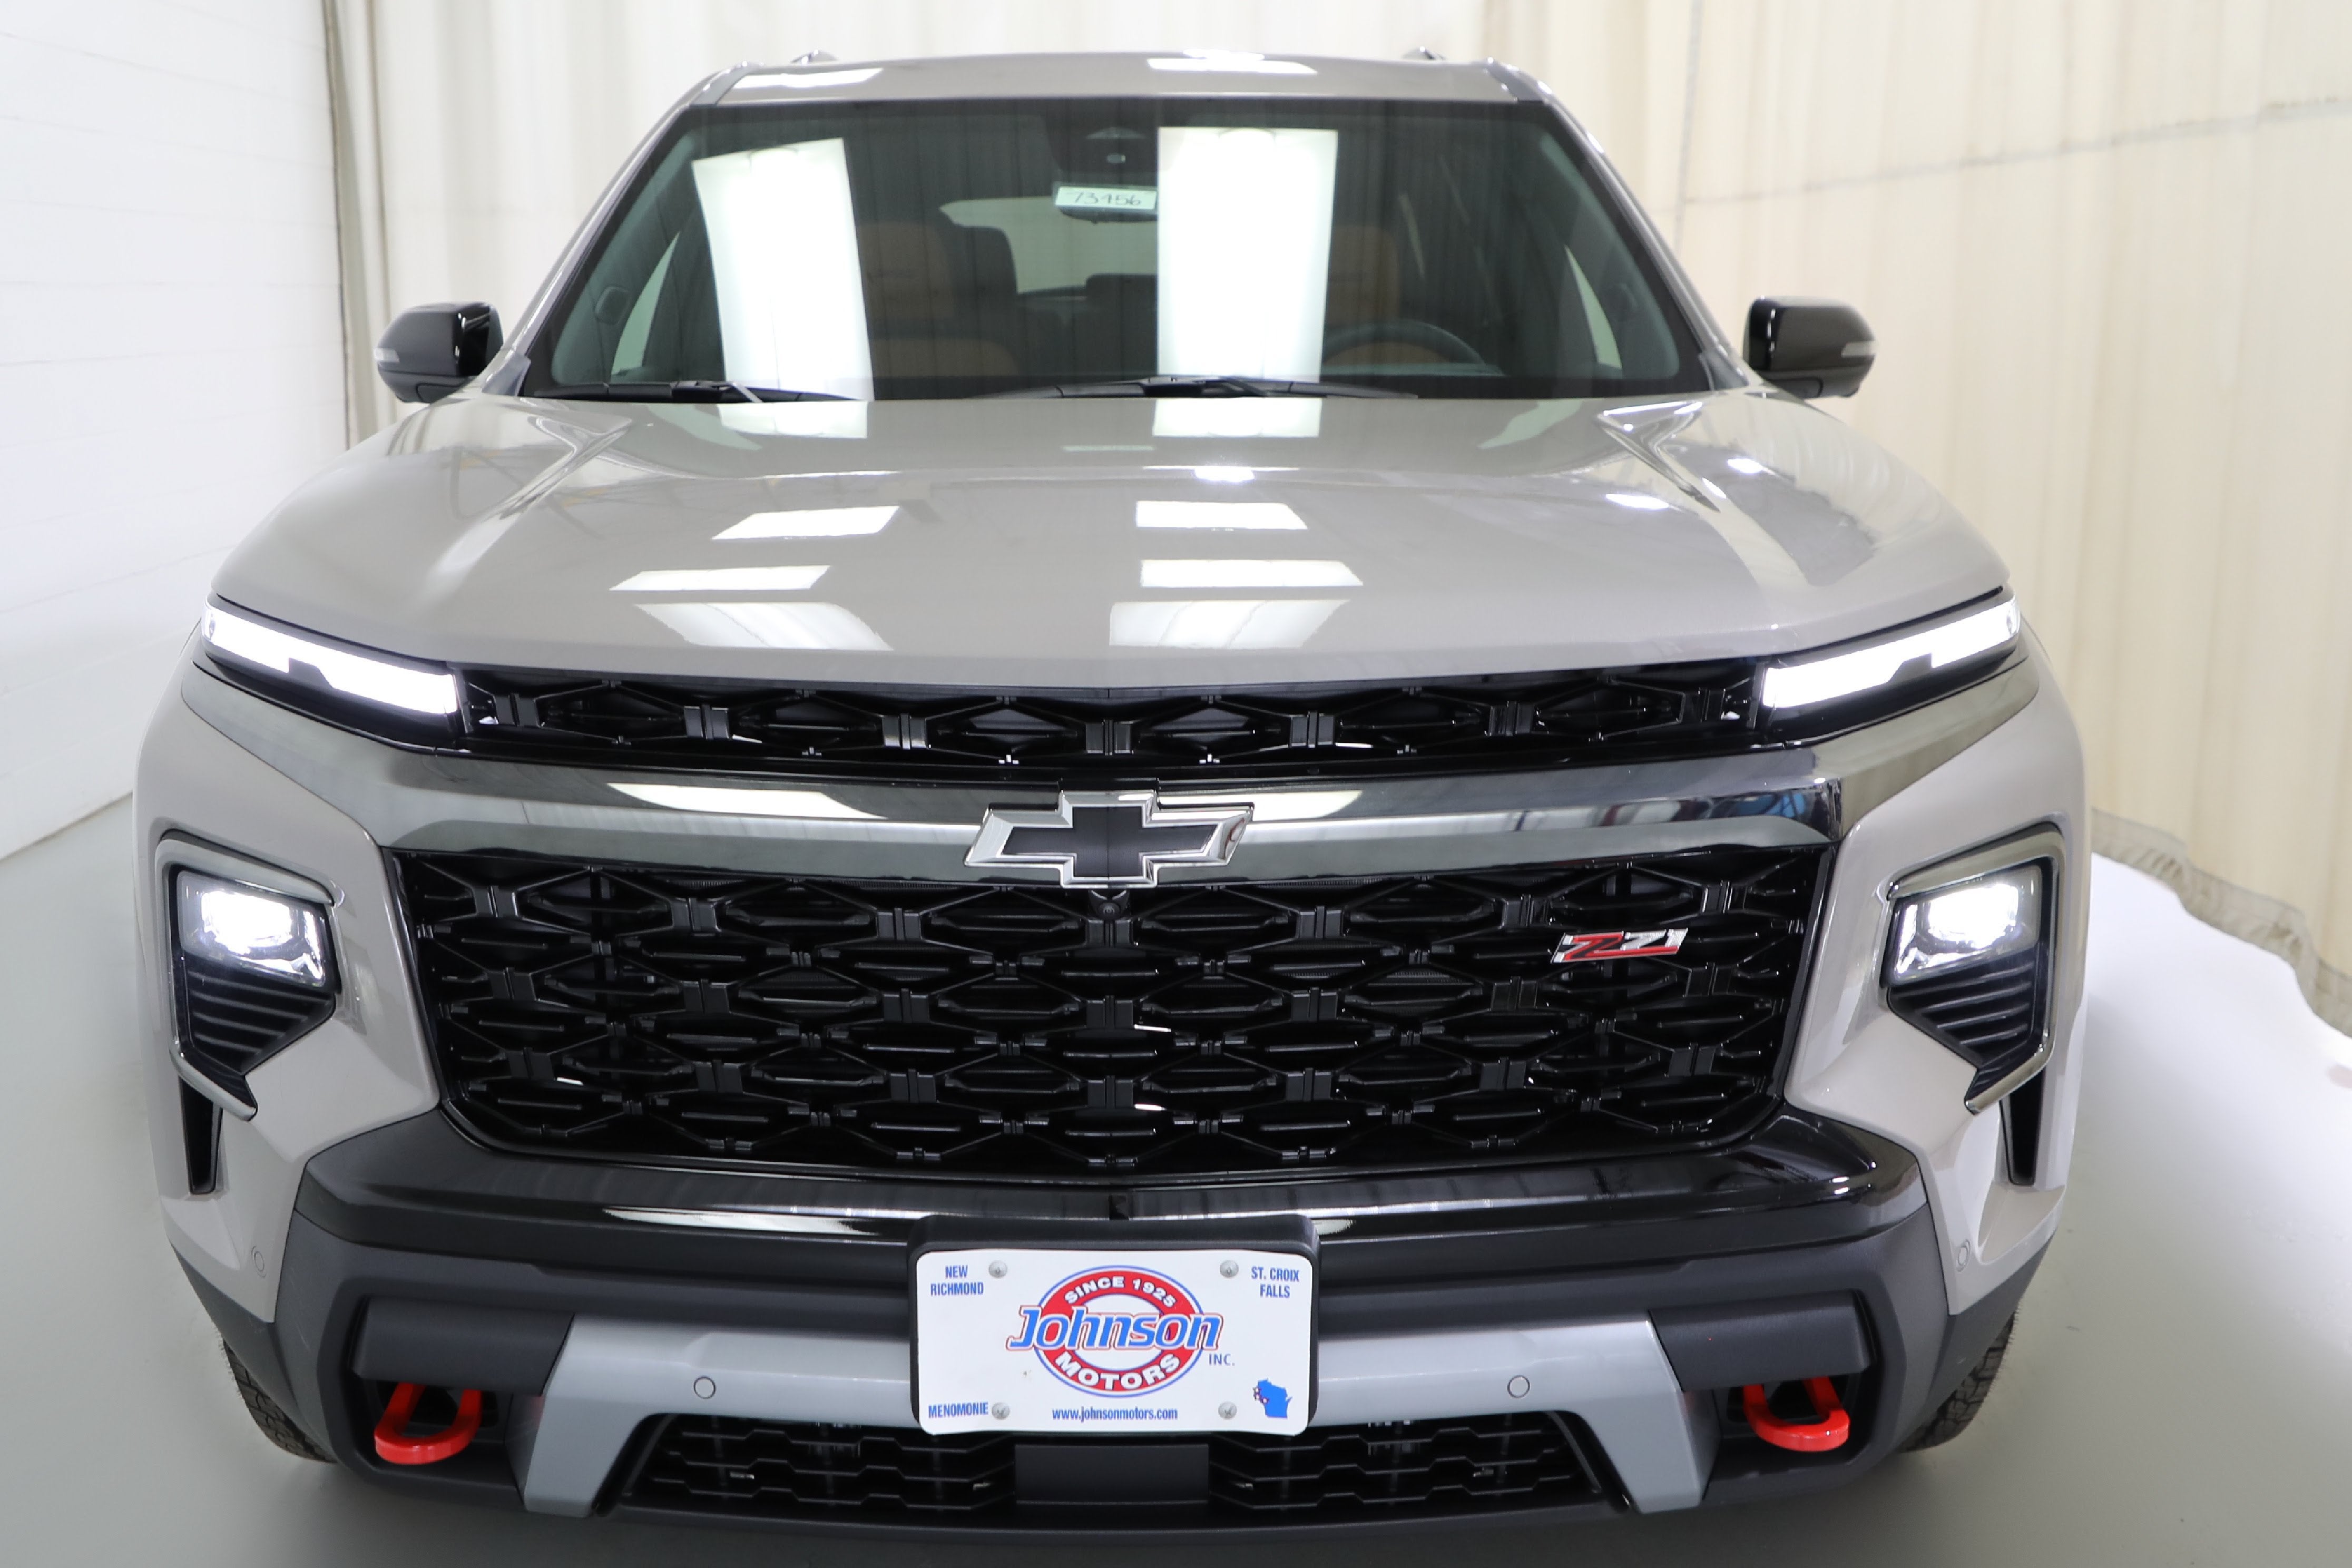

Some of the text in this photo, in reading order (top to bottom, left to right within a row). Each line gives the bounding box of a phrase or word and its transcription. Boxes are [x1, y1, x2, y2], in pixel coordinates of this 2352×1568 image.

[1550, 927, 1688, 963] Z71
[945, 1265, 968, 1279] NEW
[1251, 1266, 1300, 1282] ST. CROIX
[930, 1281, 984, 1296] RICHMOND
[1064, 1276, 1178, 1308] SINCE 1925
[1260, 1283, 1290, 1298] FALLS
[1006, 1305, 1223, 1350] Johnson
[1209, 1354, 1236, 1366] INC.
[1055, 1351, 1180, 1390] MOTORS
[928, 1402, 989, 1418] MENOMONIE
[1052, 1406, 1178, 1422] www.johnsonmotors.com
